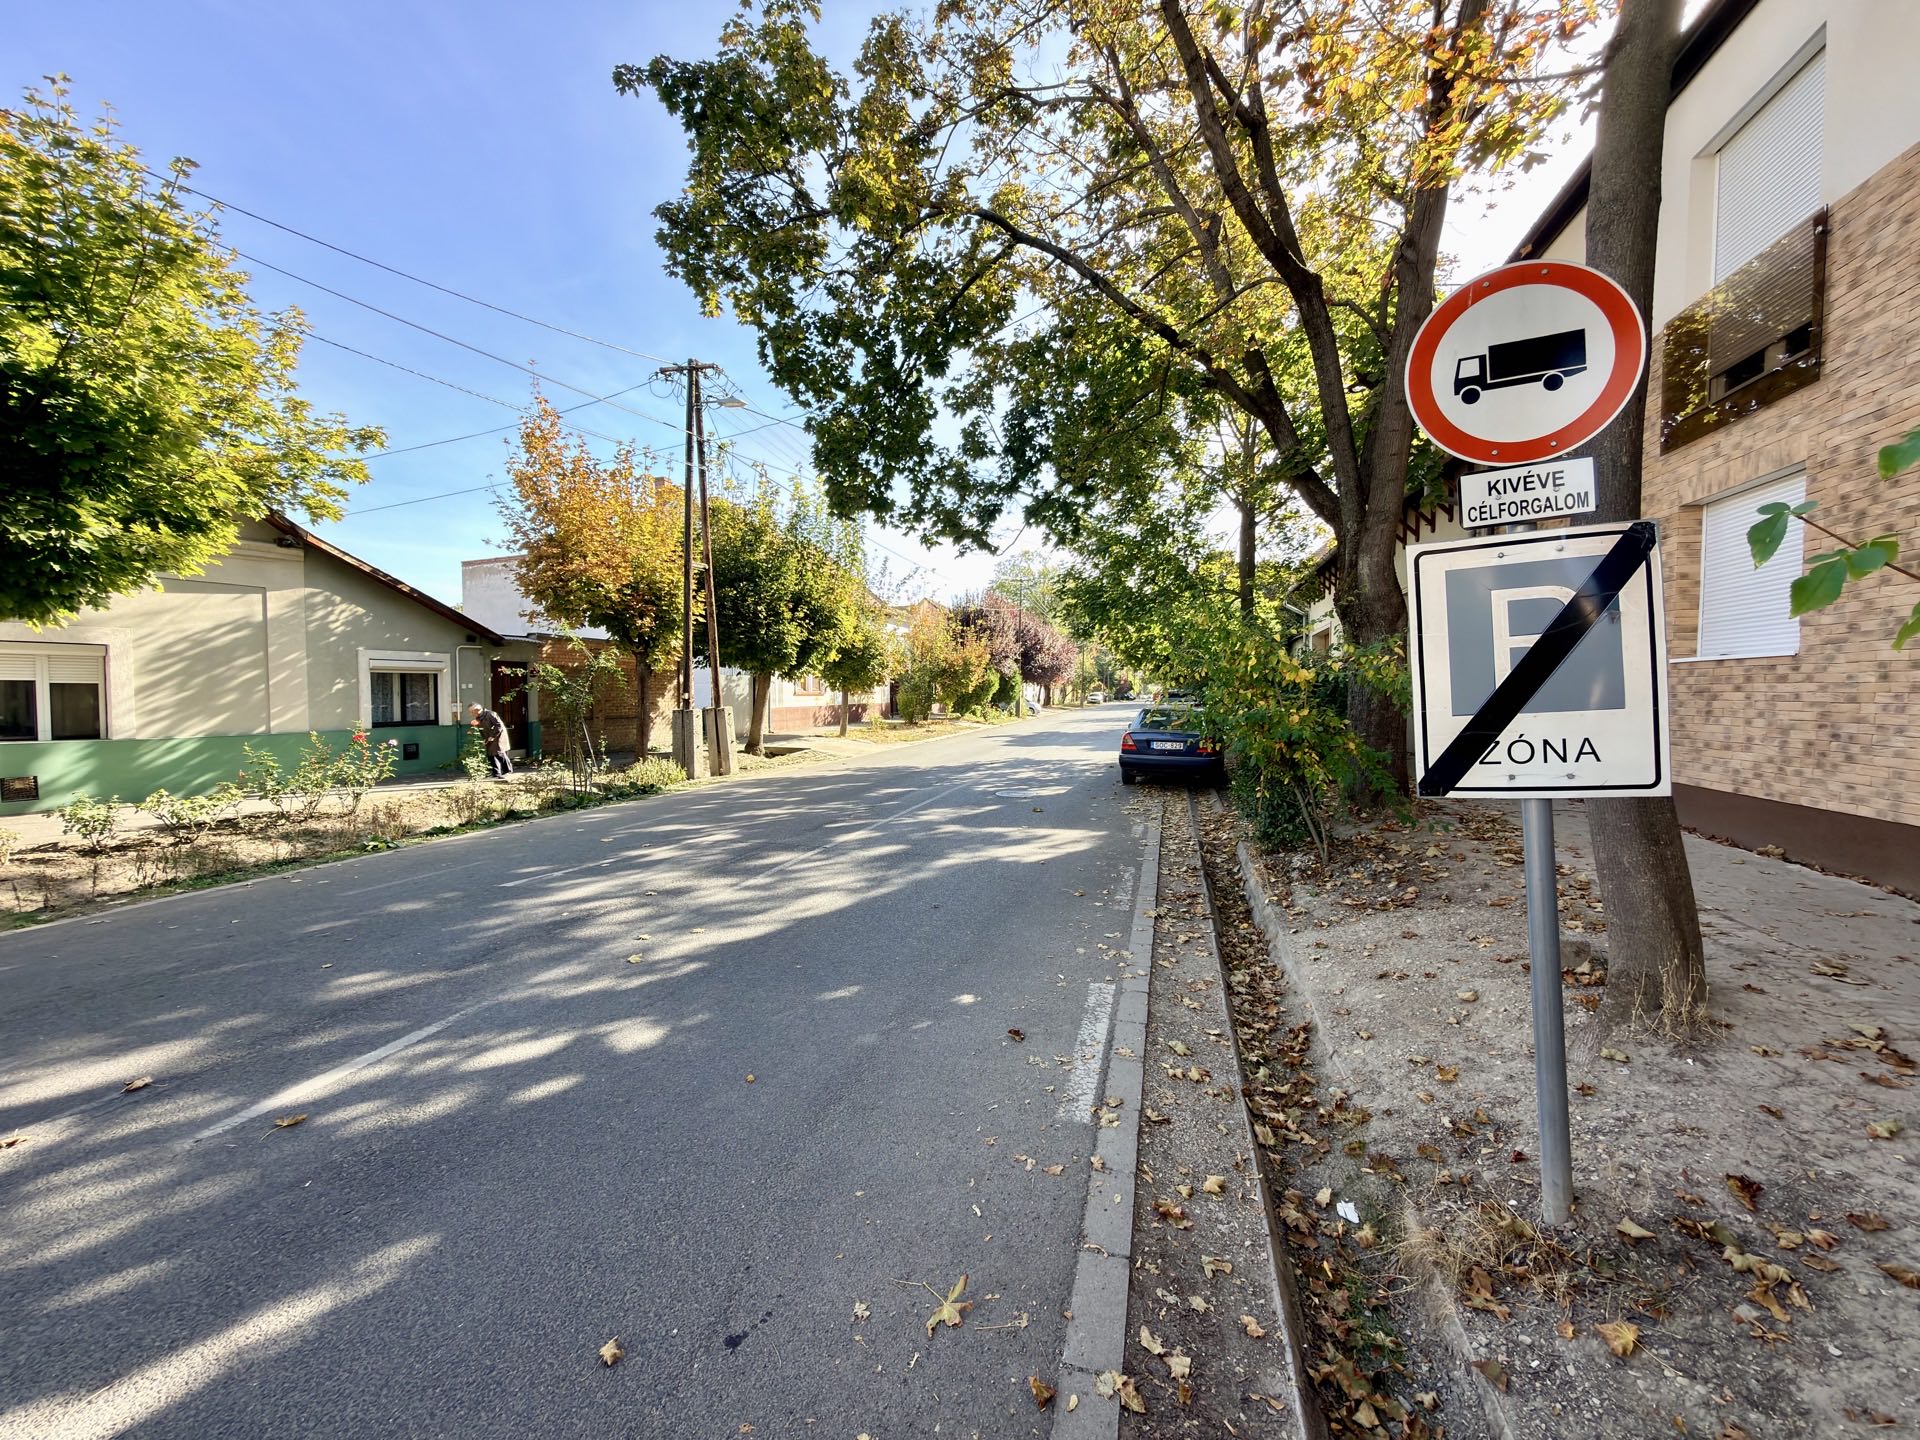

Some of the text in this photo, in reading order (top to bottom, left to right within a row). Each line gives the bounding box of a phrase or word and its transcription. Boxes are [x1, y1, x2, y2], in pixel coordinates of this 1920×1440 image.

[1487, 470, 1565, 496] KIVÉVE
[1468, 491, 1589, 522] CÉLFORGALOM
[1478, 734, 1601, 765] ZÓNA
